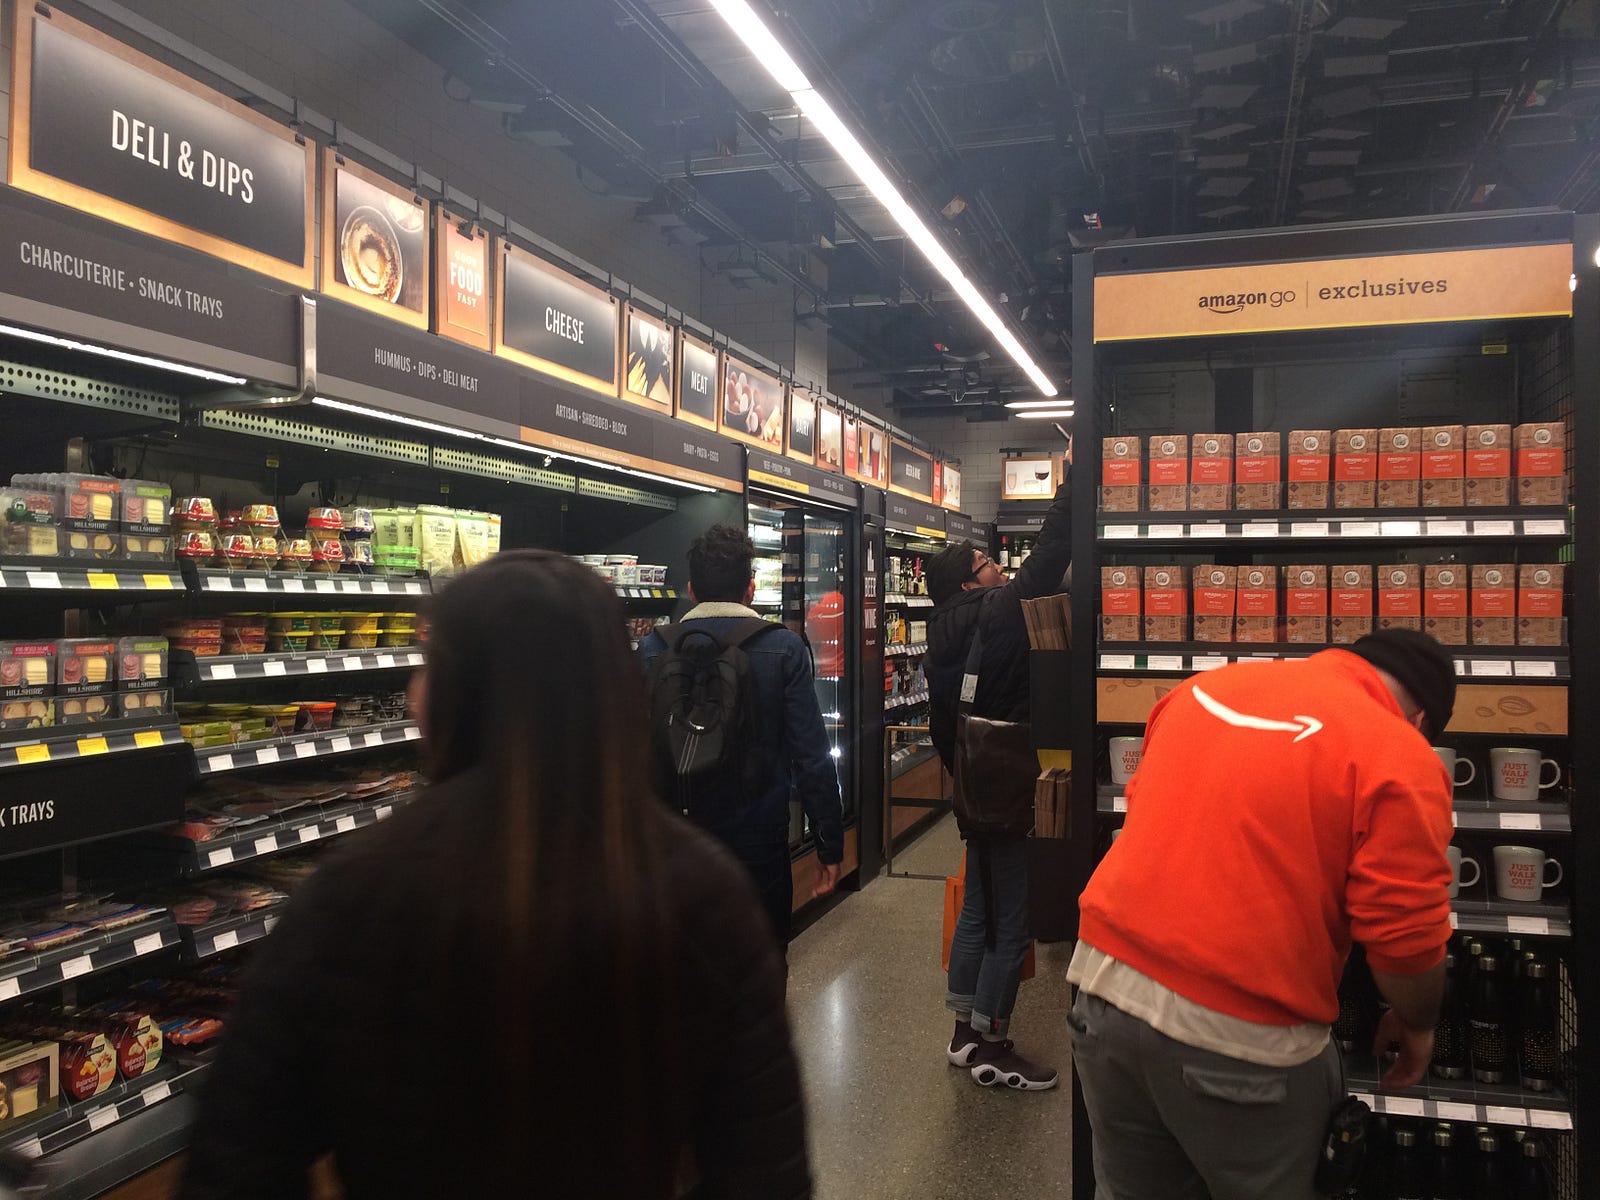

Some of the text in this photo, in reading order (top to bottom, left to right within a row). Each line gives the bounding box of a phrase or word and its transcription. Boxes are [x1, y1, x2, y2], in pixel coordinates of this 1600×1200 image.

[112, 110, 254, 204] DELI & DIPS
[20, 242, 224, 319] CHARCUTERIE SNACK TRAYS
[450, 261, 482, 296] FOOD
[1318, 278, 1448, 300] exclusives
[457, 292, 477, 307] FAST
[1198, 290, 1296, 308] amazon go
[545, 306, 585, 345] CHEESE
[374, 347, 479, 393] HUMMUS DIPS DELI MEAT
[690, 370, 709, 396] MEAT
[555, 403, 579, 422] ARTISAN
[612, 420, 627, 436] BLOCK
[10, 800, 55, 826] TRAYS
